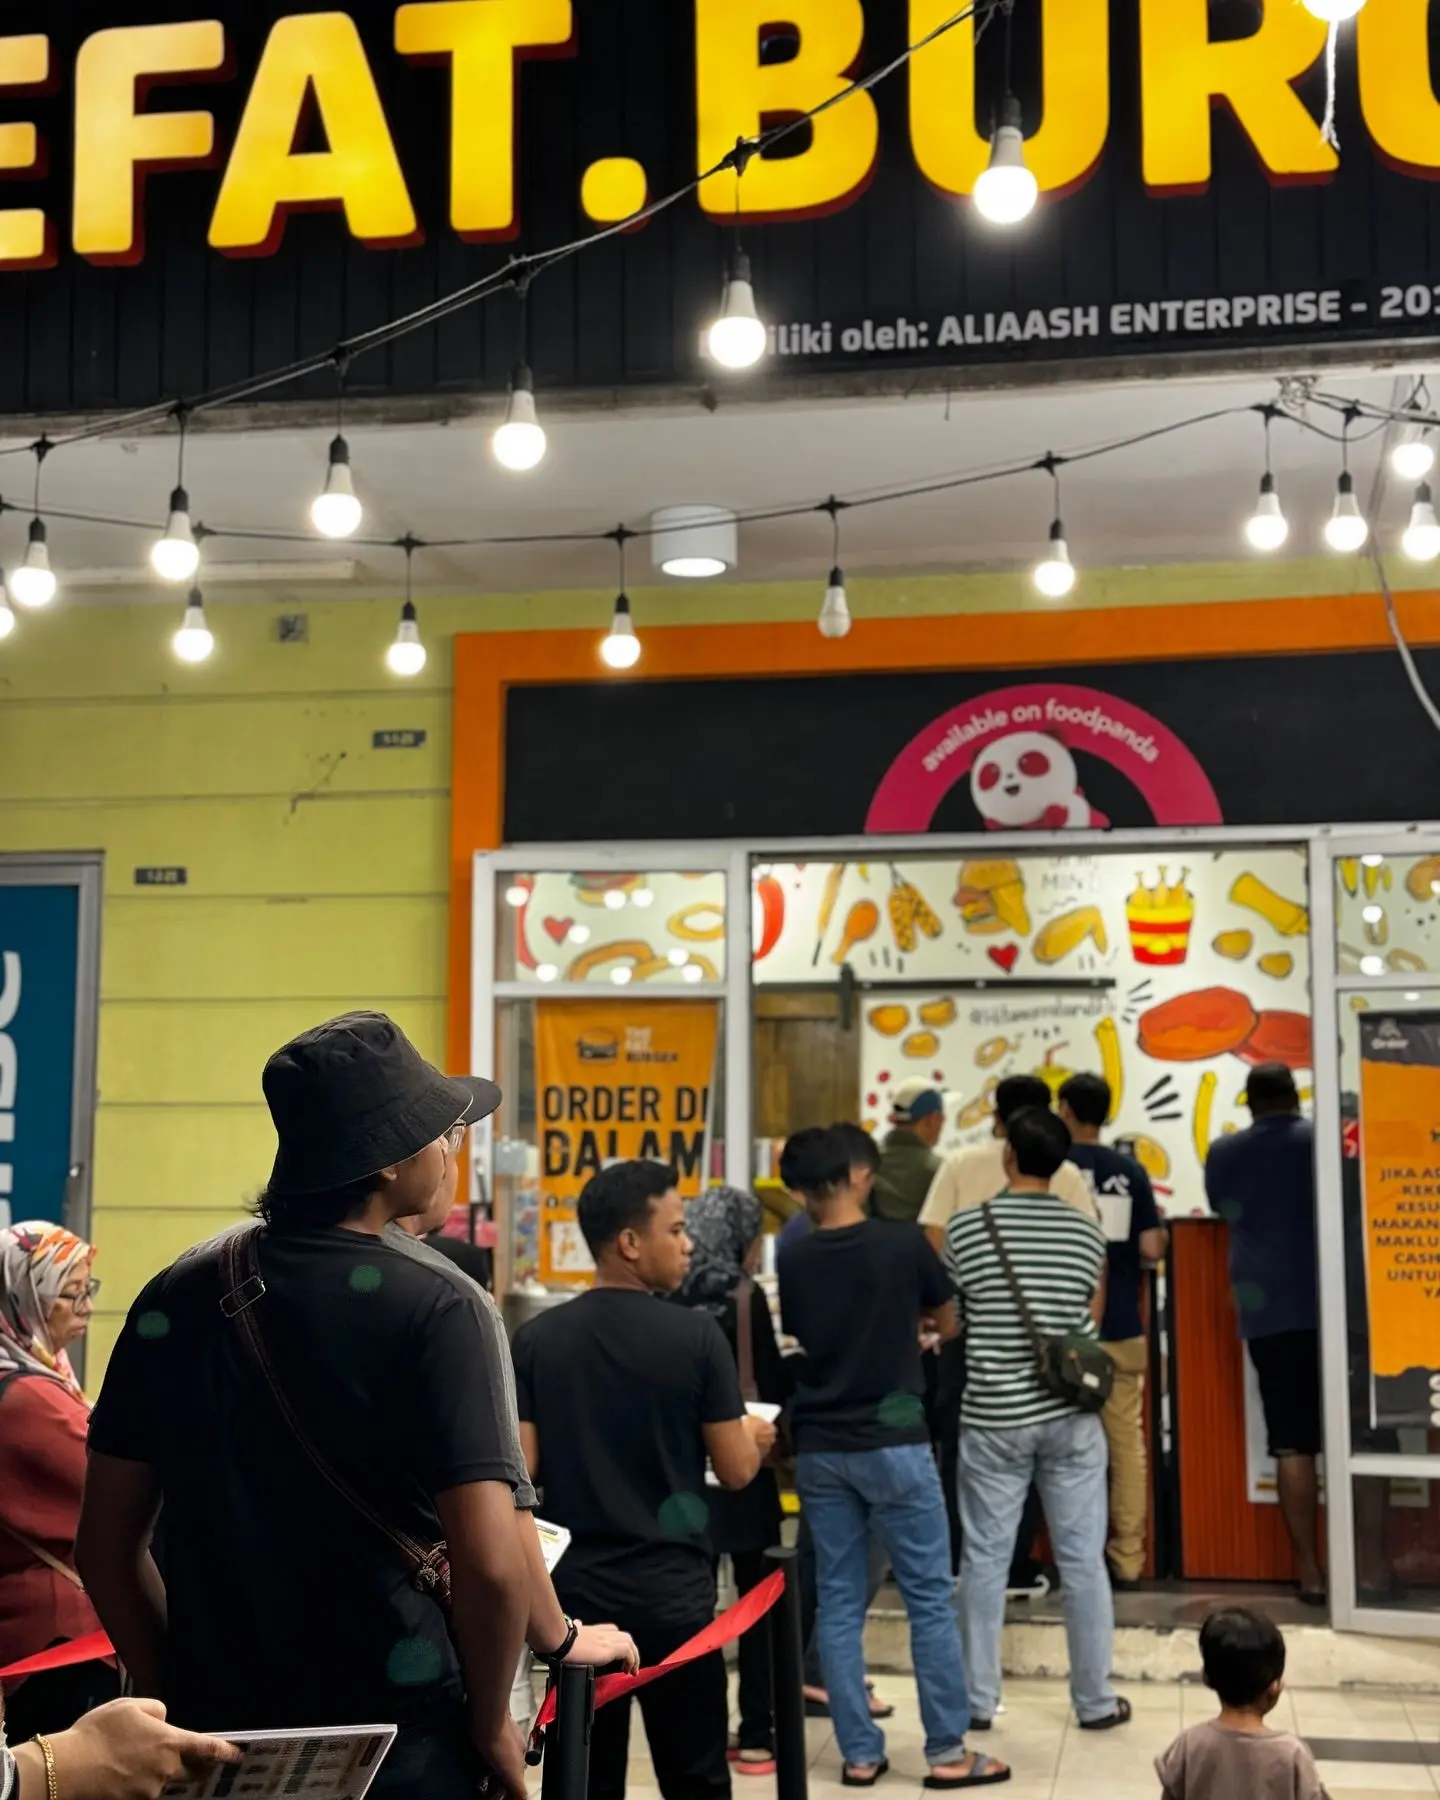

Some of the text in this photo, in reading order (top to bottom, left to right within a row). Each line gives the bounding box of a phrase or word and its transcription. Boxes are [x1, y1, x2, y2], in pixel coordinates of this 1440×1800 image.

[841, 318, 928, 352] oleh:
[937, 306, 1099, 346] ALIAASH
[1110, 290, 1341, 334] ENTERPRISE
[1351, 301, 1368, 312] -
[922, 698, 1159, 773] available on foodpanda
[543, 1086, 660, 1122] ORDER
